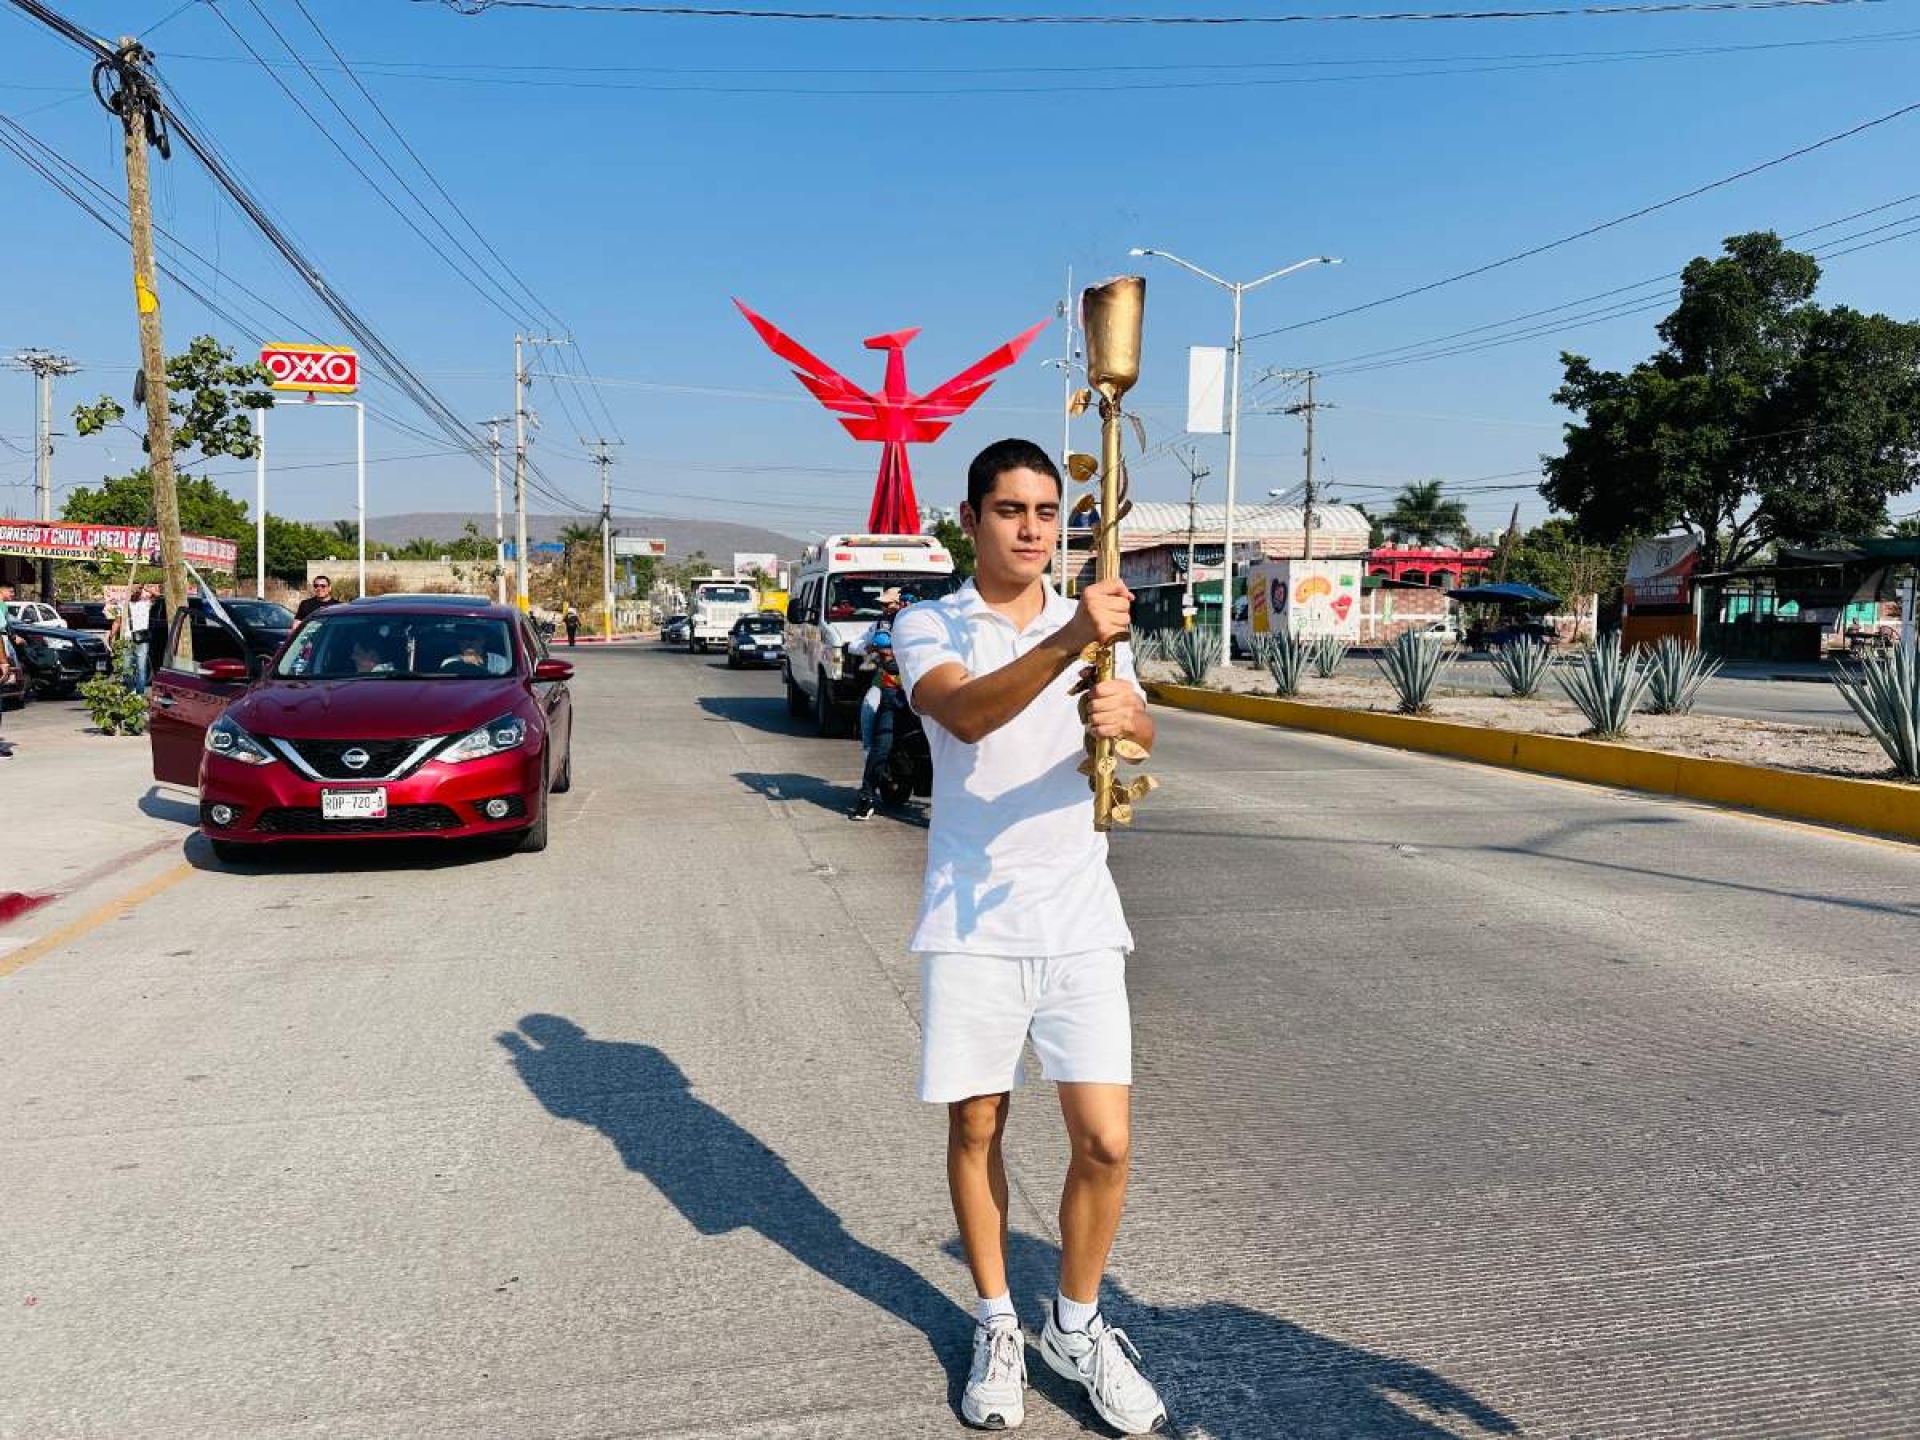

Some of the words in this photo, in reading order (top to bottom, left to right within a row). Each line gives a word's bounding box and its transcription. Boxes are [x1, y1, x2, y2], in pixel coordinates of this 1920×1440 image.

[267, 353, 351, 382] OXXO
[42, 528, 51, 544] Y
[88, 530, 126, 548] CABEZA
